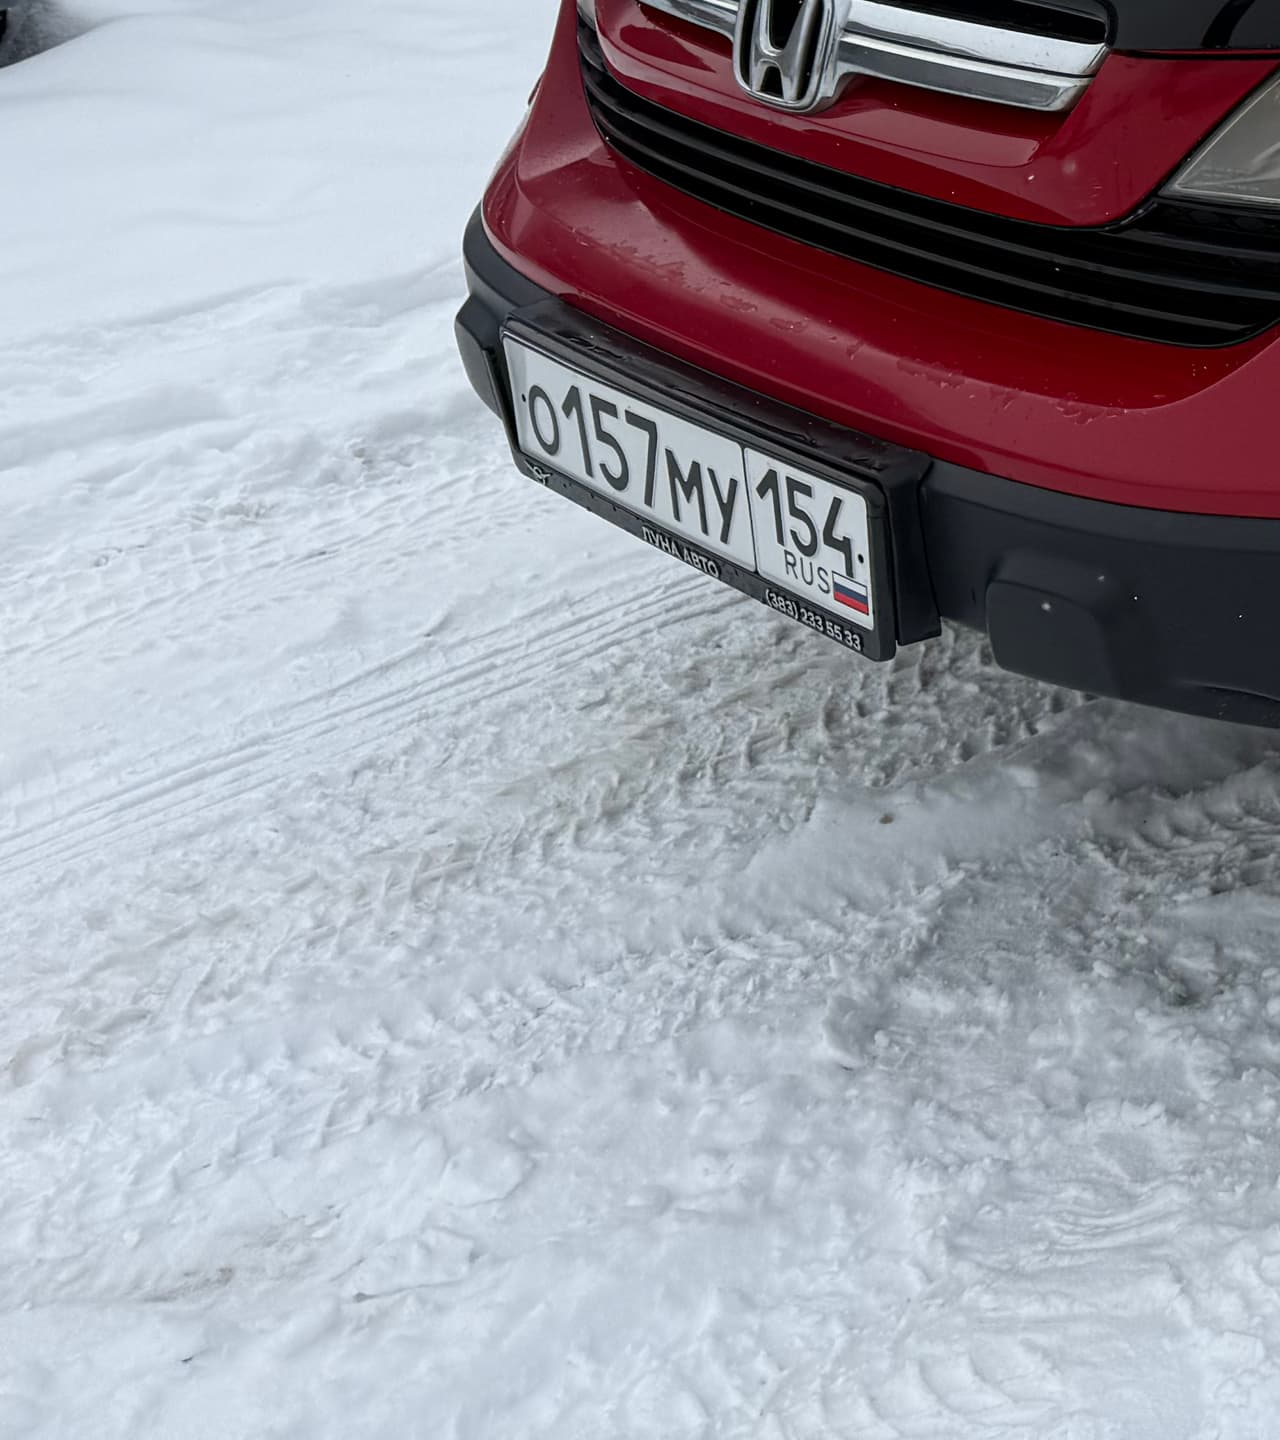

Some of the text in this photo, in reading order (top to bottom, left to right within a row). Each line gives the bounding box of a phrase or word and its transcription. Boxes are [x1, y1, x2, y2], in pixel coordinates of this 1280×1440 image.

[528, 384, 856, 579] О157МУ 154
[641, 526, 720, 579] ЛУНА АВТО
[783, 549, 831, 595] RUS
[765, 588, 862, 651] (383) 233 55 33
